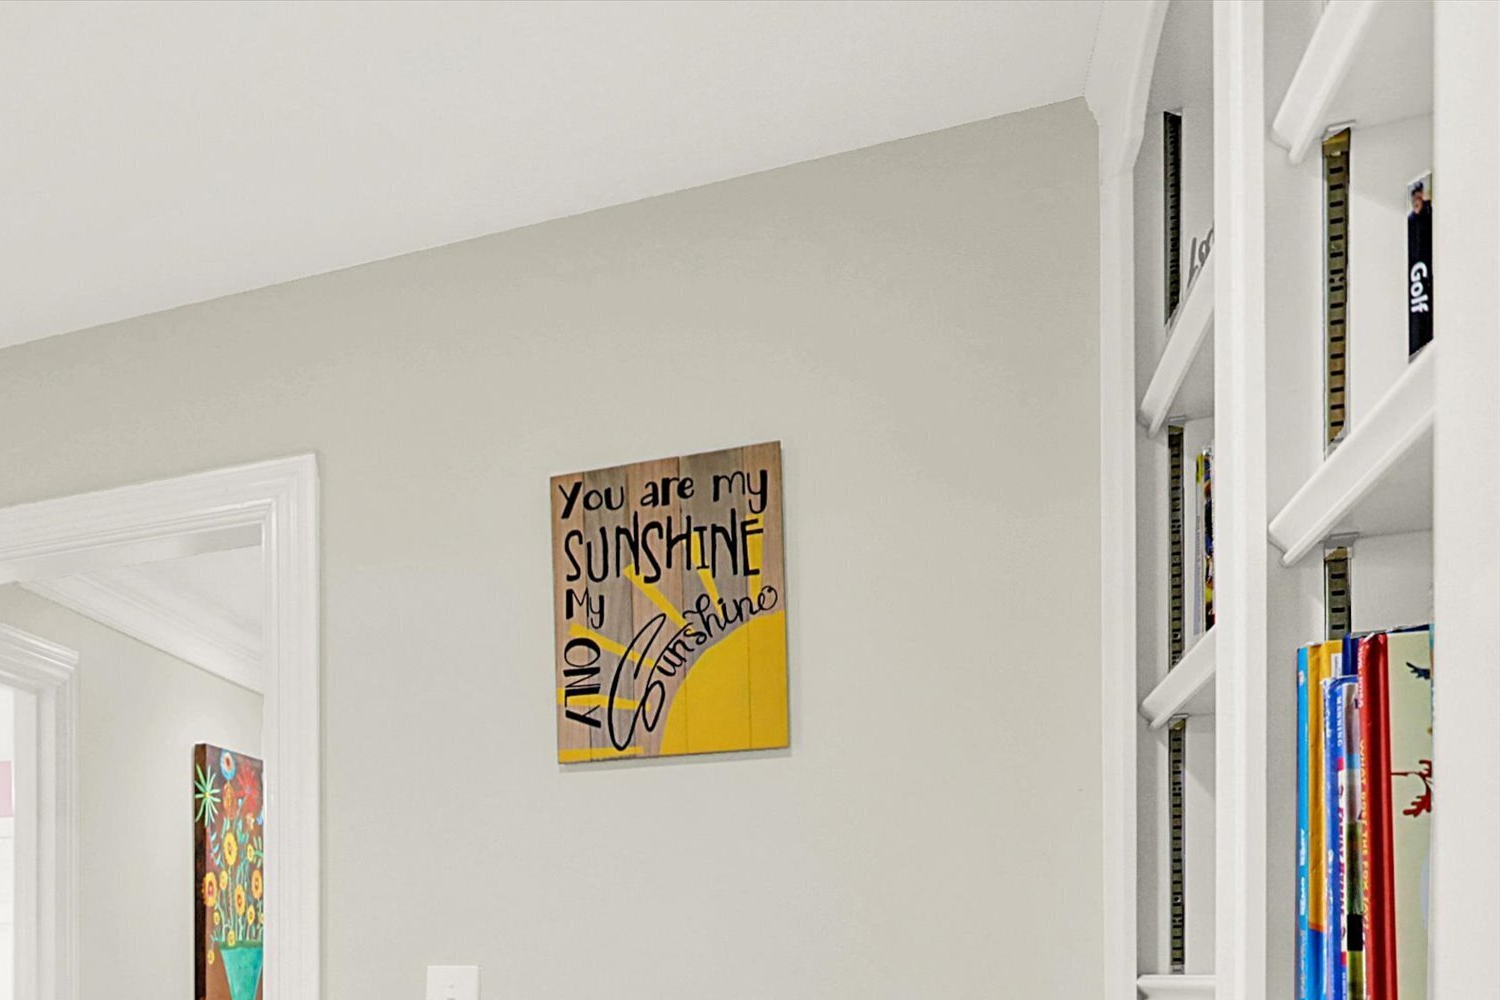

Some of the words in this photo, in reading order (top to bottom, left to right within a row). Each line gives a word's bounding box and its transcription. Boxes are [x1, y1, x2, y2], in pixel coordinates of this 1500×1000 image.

[1409, 261, 1428, 314] Golf
[558, 481, 625, 519] You
[640, 476, 694, 507] are
[713, 469, 768, 514] my
[564, 508, 764, 584] SUNSHINE
[563, 637, 602, 728] ONLY
[607, 585, 778, 751] Sunshine
